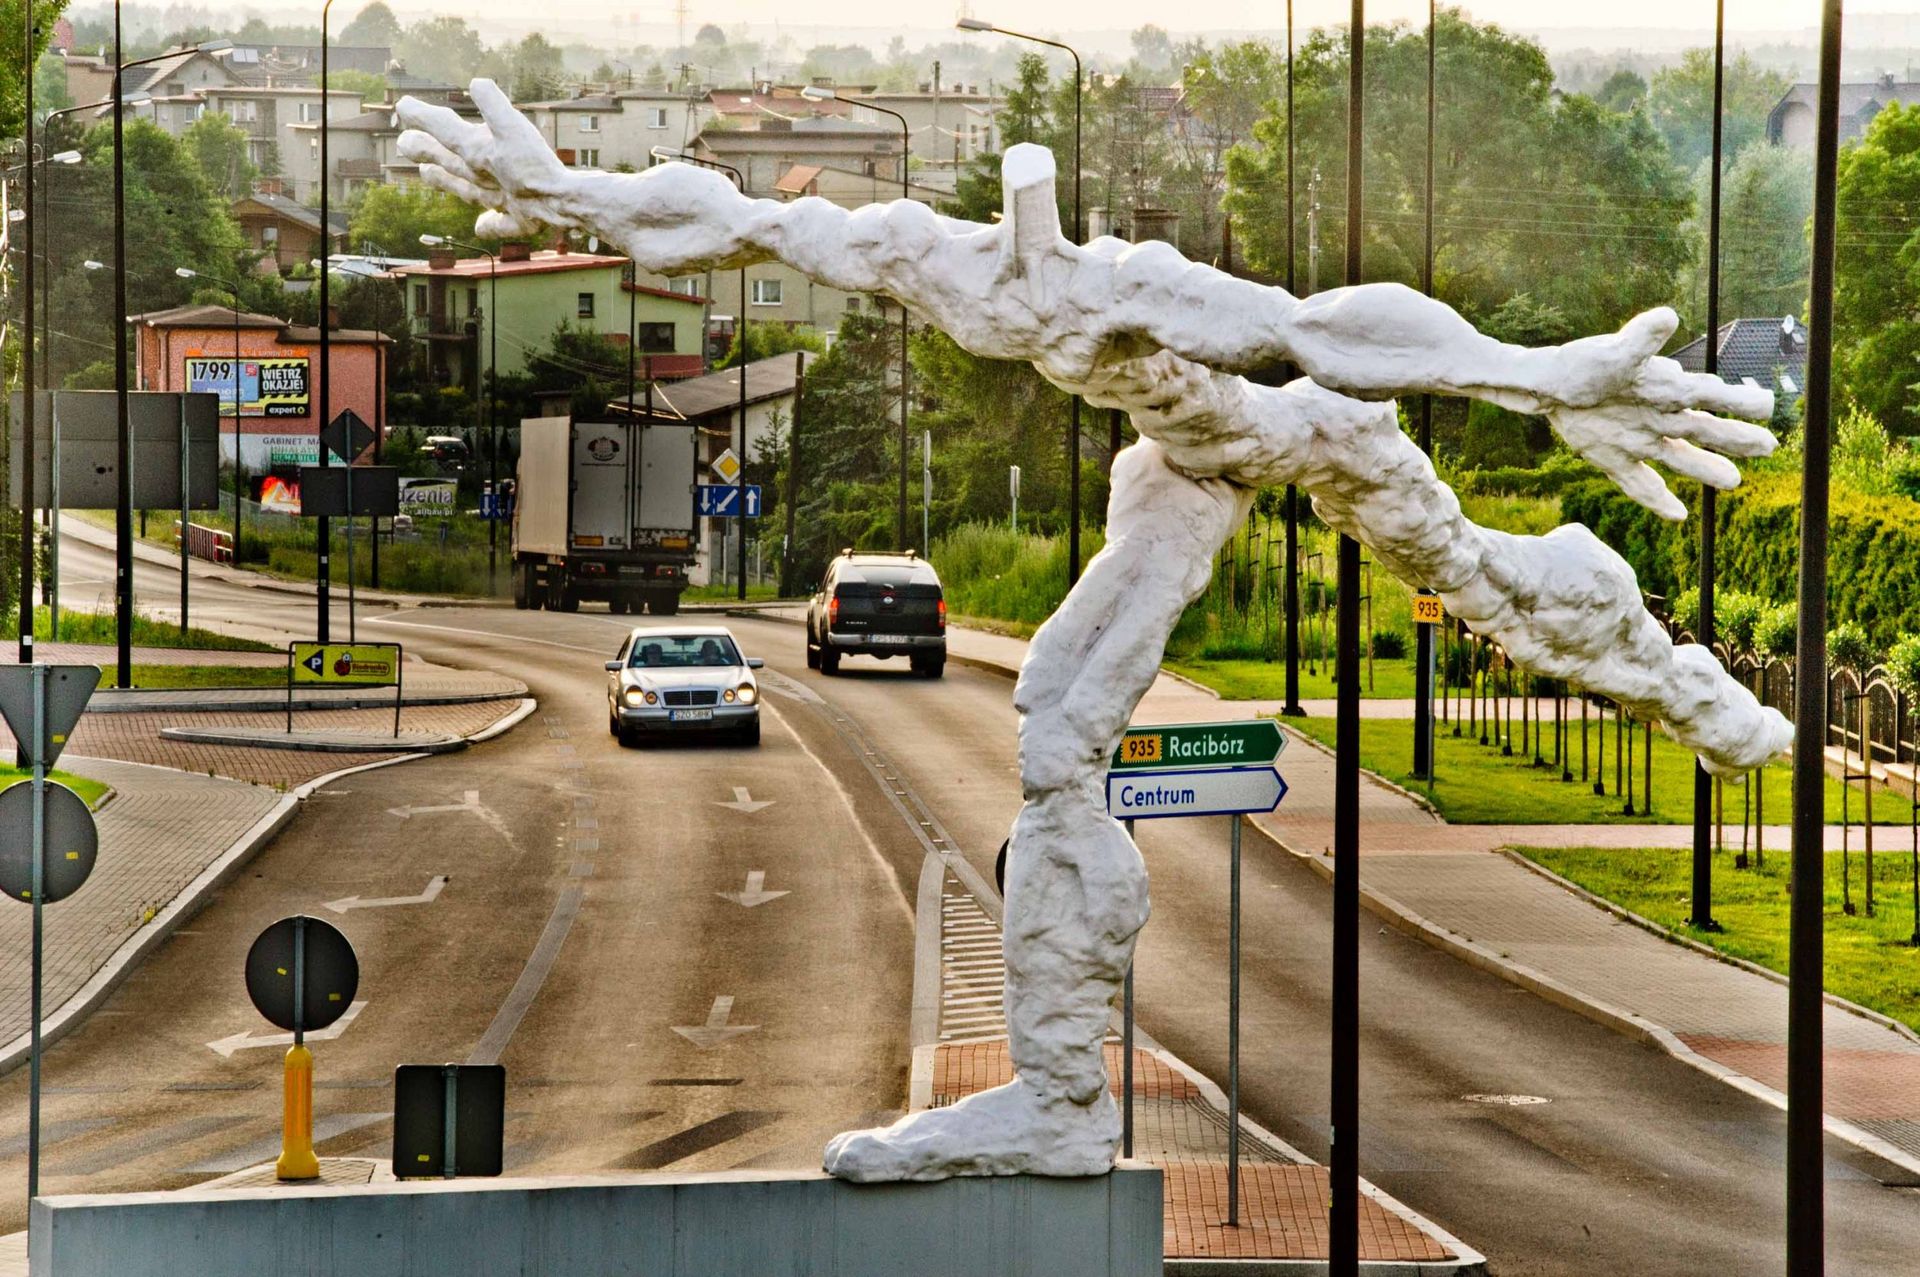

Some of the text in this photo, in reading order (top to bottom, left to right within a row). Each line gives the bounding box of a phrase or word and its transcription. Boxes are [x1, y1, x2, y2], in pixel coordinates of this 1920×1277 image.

[262, 368, 301, 380] WIETRZ
[262, 379, 304, 391] OKAZJE!
[269, 406, 296, 416] expert
[262, 436, 302, 445] GABINET
[1418, 601, 1438, 617] 935
[311, 658, 322, 669] P
[1129, 733, 1244, 757] 935 Racibórz
[1121, 785, 1195, 807] Centrum
